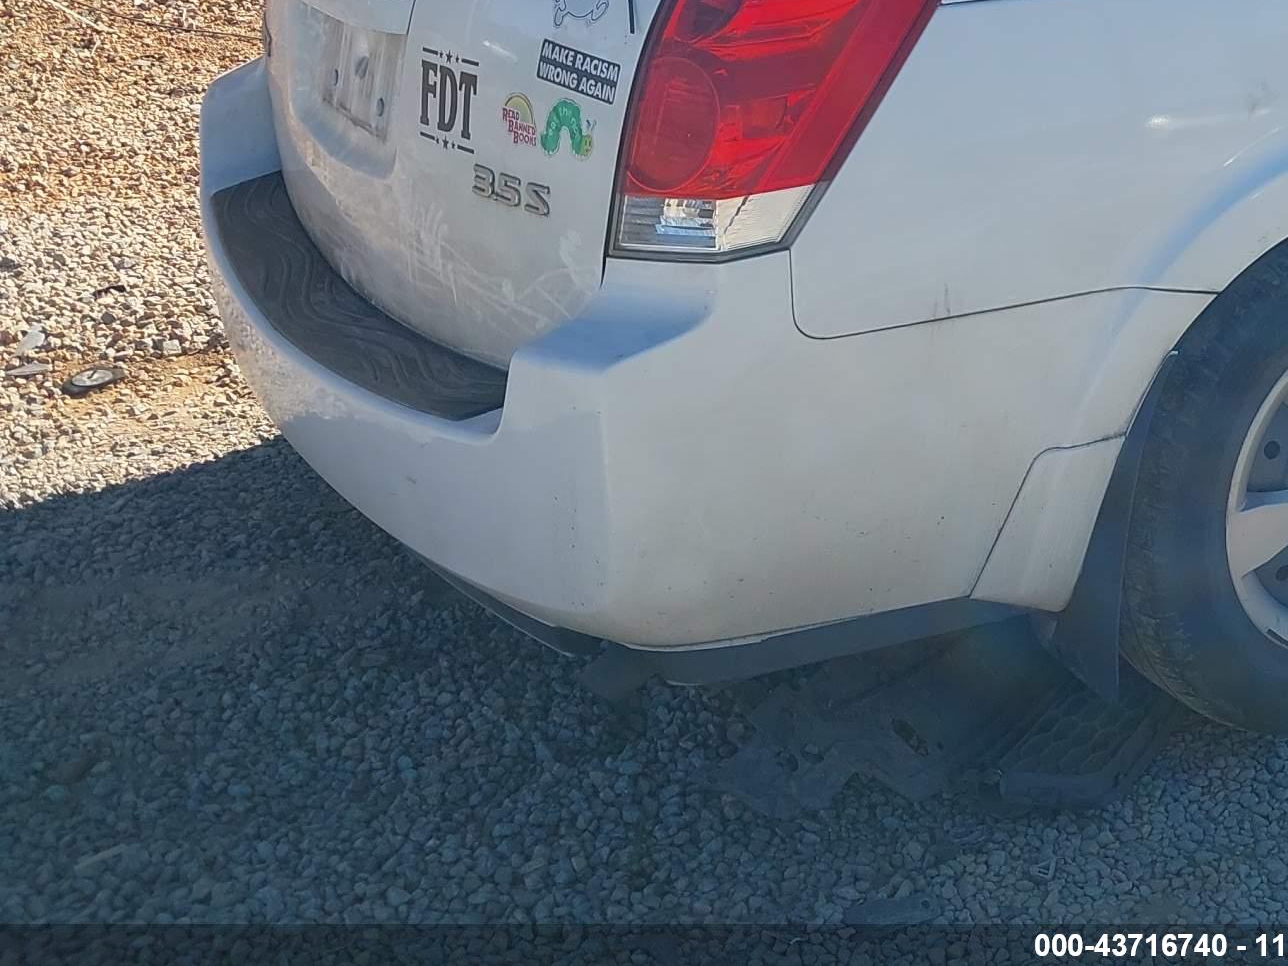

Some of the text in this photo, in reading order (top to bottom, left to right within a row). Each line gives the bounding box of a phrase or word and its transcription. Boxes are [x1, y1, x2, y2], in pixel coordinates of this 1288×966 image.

[542, 41, 619, 82] MAKE RACISM
[540, 61, 615, 102] WRONG AGAIN
[420, 59, 478, 140] FDT
[502, 107, 520, 122] READ
[508, 120, 537, 136] BANNED
[513, 130, 537, 147] BOOKS
